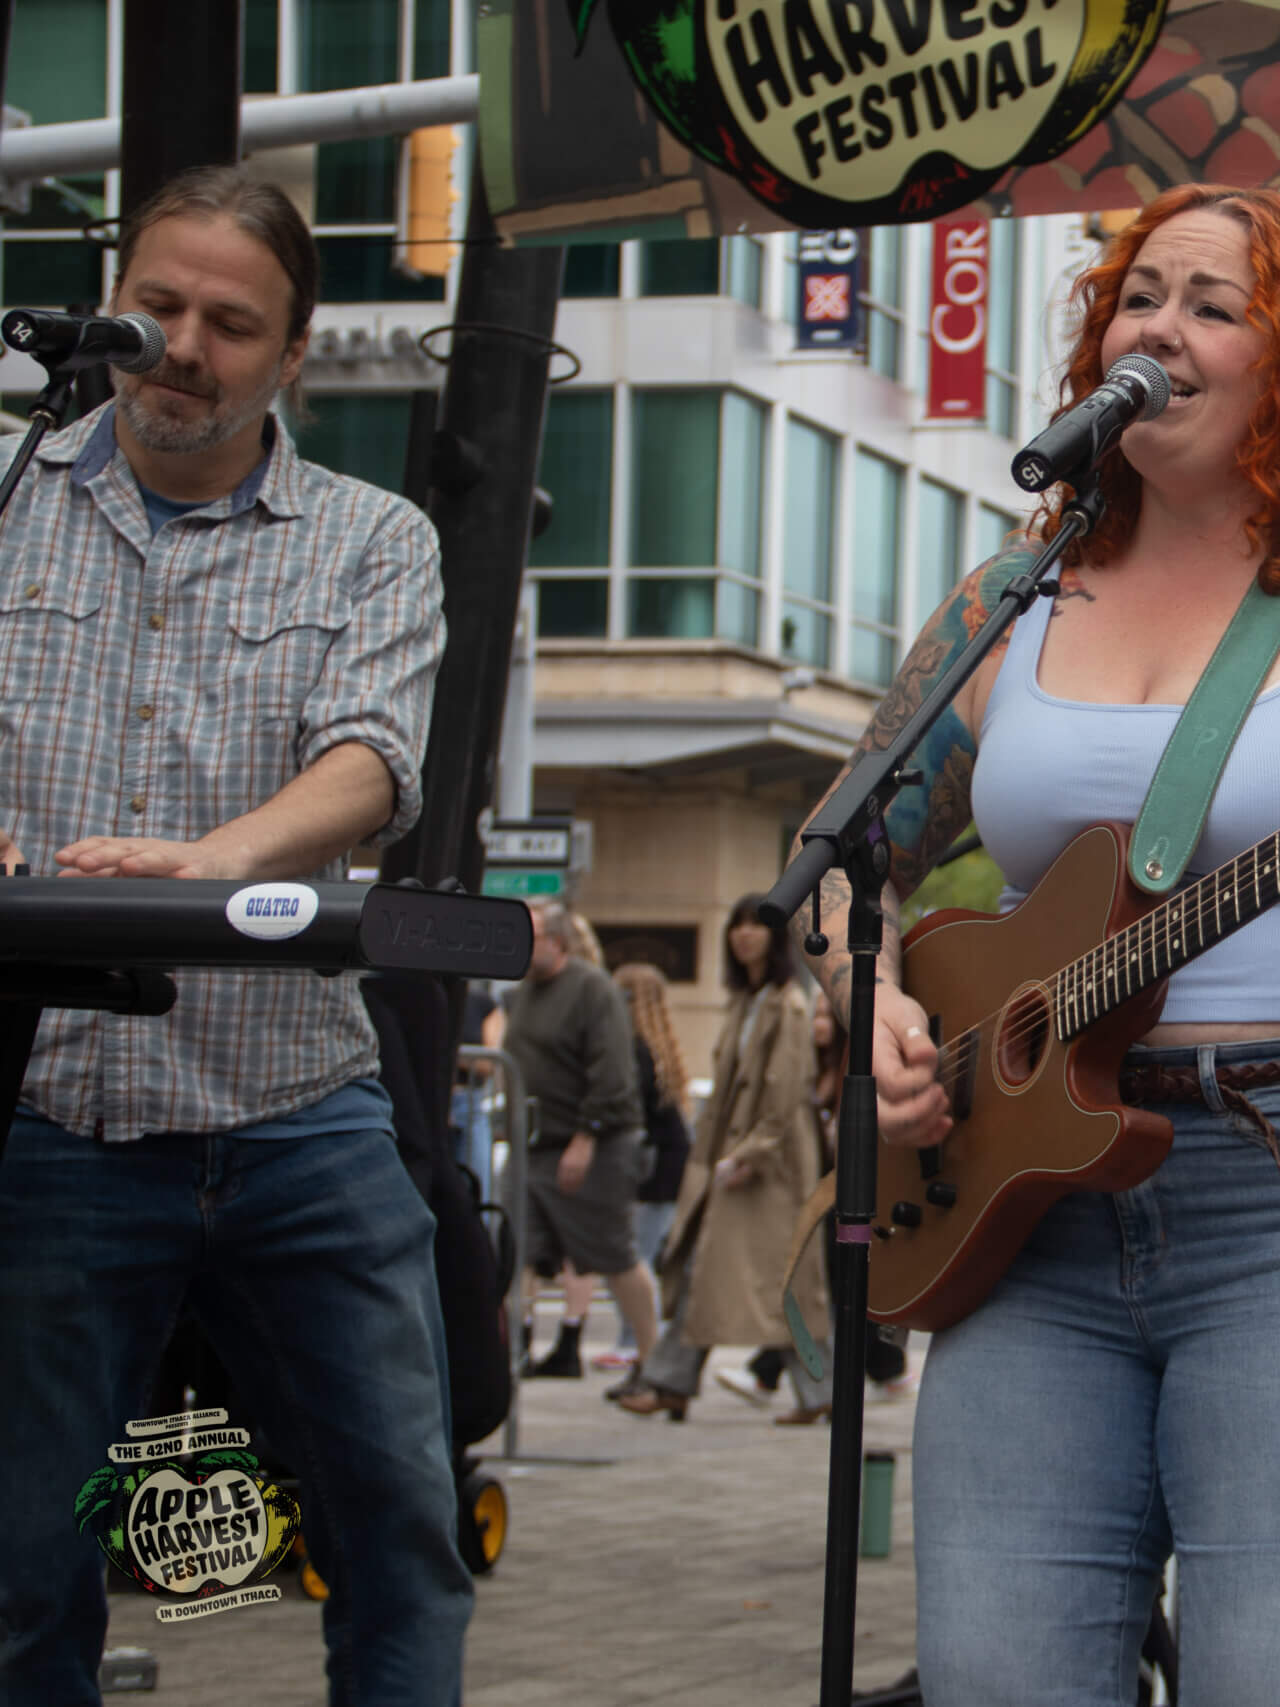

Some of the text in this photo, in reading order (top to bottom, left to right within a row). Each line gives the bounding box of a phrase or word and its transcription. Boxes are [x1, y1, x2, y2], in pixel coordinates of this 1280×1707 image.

[724, 0, 1063, 122] HARVE
[794, 26, 1056, 180] FESTIVAL
[11, 321, 33, 343] 14
[1022, 462, 1044, 487] 15
